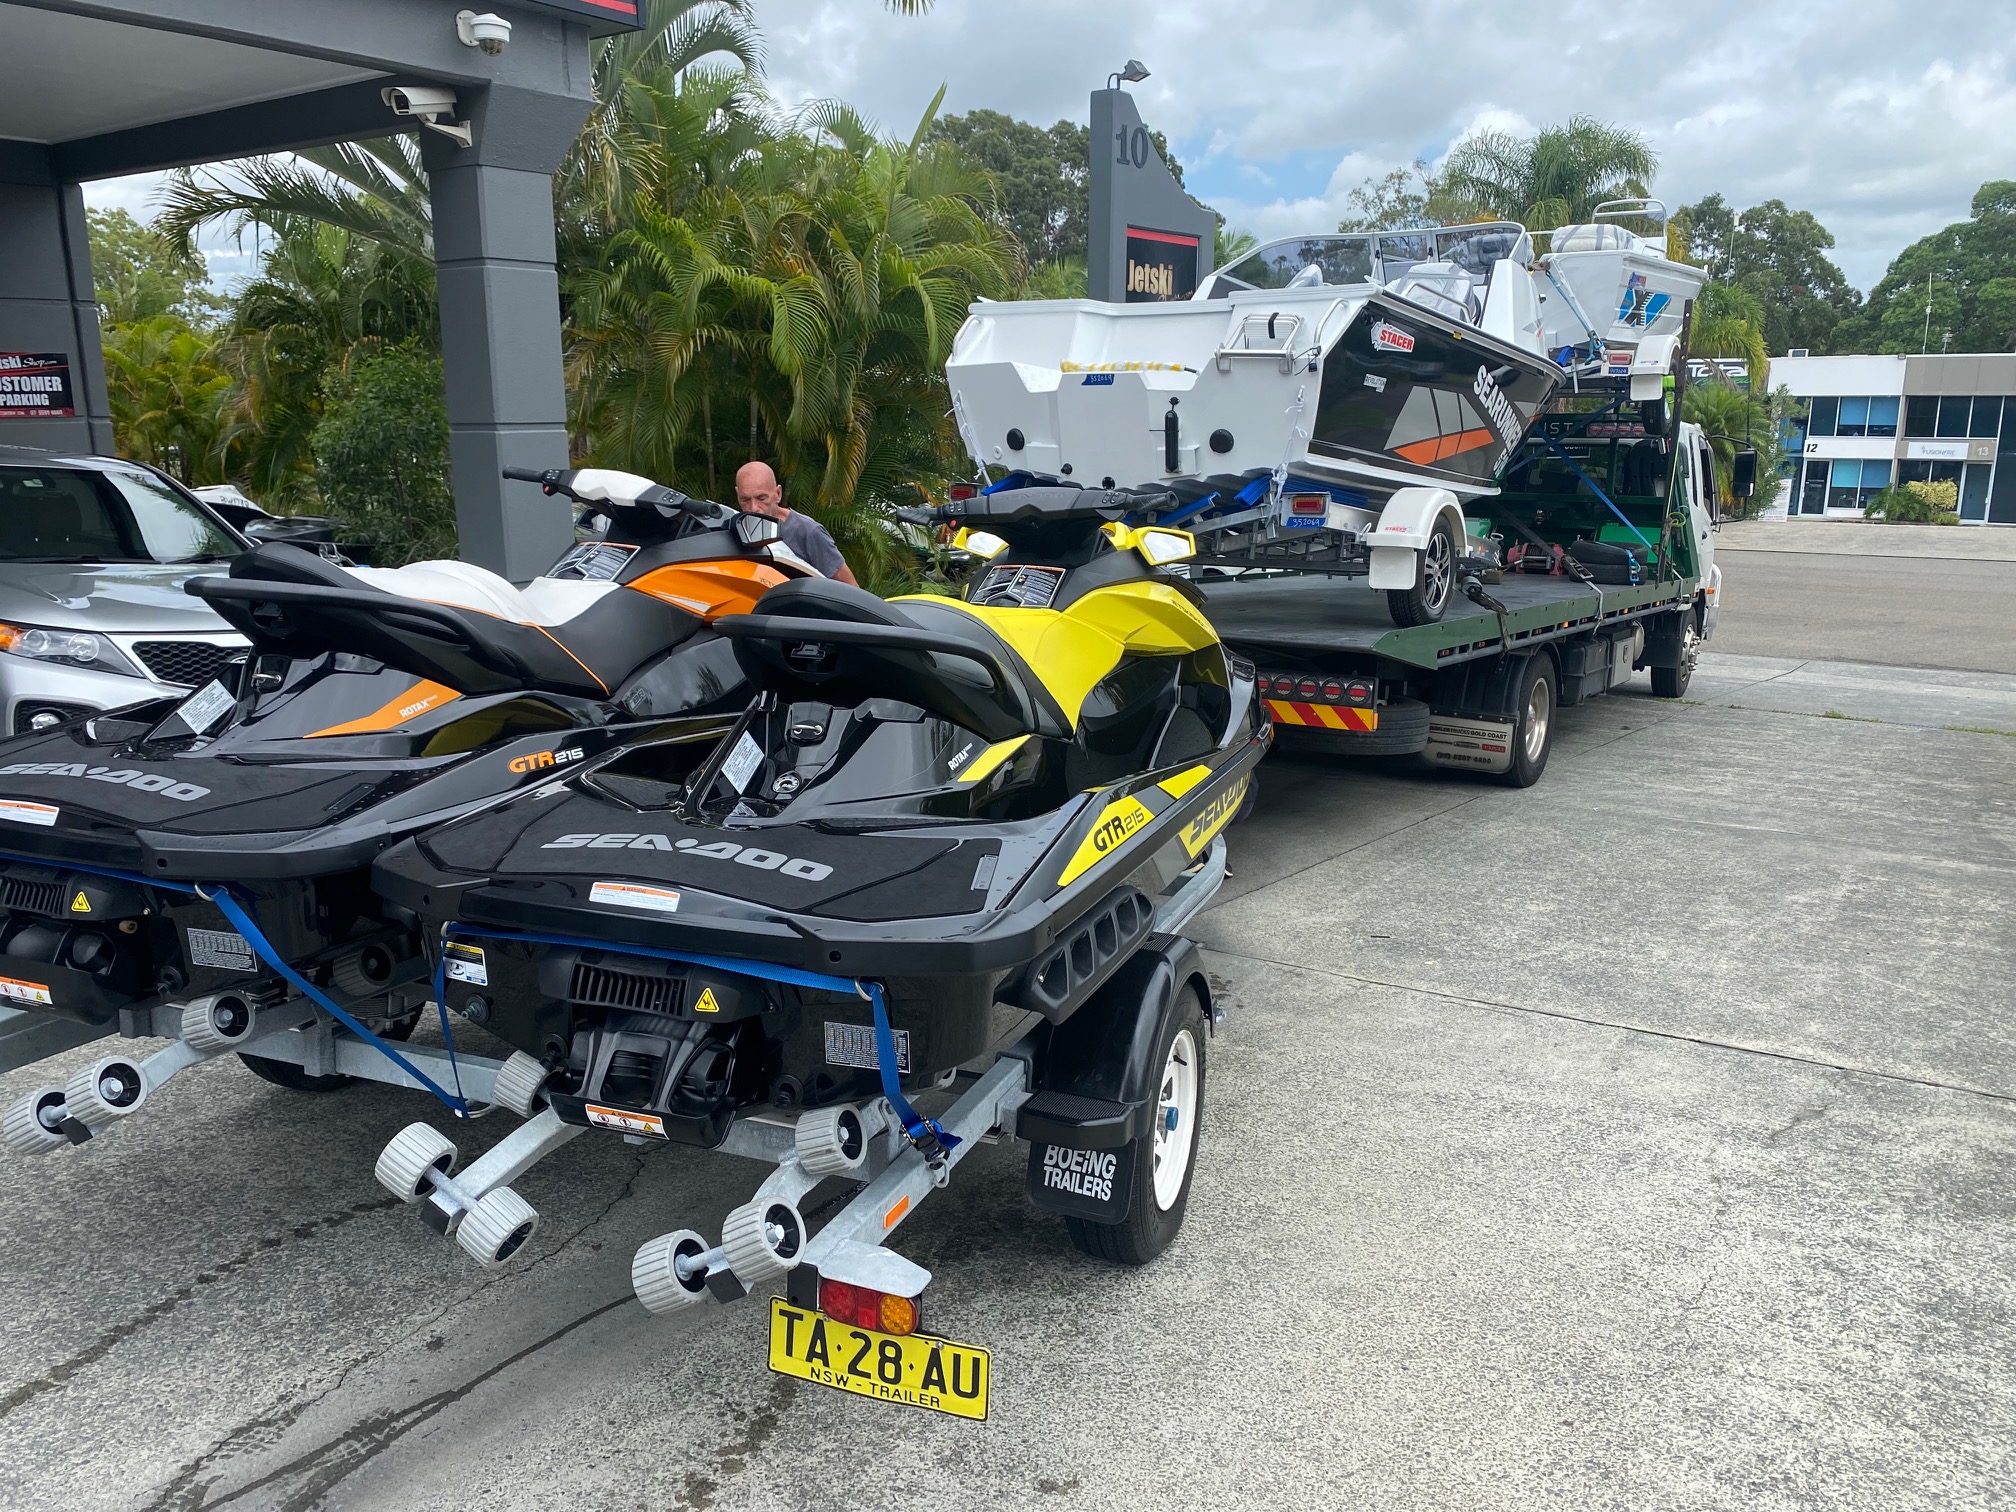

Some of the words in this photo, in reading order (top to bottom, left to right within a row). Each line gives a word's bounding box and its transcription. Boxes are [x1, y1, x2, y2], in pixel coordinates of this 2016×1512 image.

[1116, 124, 1149, 168] 10
[1127, 259, 1173, 295] Jetski
[1380, 329, 1414, 351] STACER
[0, 376, 63, 391] STOMER
[0, 393, 50, 406] PARKING
[1805, 443, 1818, 453] 12
[1976, 447, 1989, 456] 13
[1292, 518, 1321, 528] 352069
[399, 699, 430, 718] ROTAX
[1470, 730, 1487, 738] GOLD
[1487, 732, 1508, 740] COAST
[508, 750, 555, 774] GTR
[554, 747, 585, 764] 215
[947, 749, 969, 771] ROTAX
[1093, 815, 1127, 852] GTR
[1123, 807, 1146, 833] 215
[1043, 1165, 1113, 1202] TRAILERS
[810, 1366, 850, 1388] NSW
[868, 1382, 942, 1409] TRAILER
